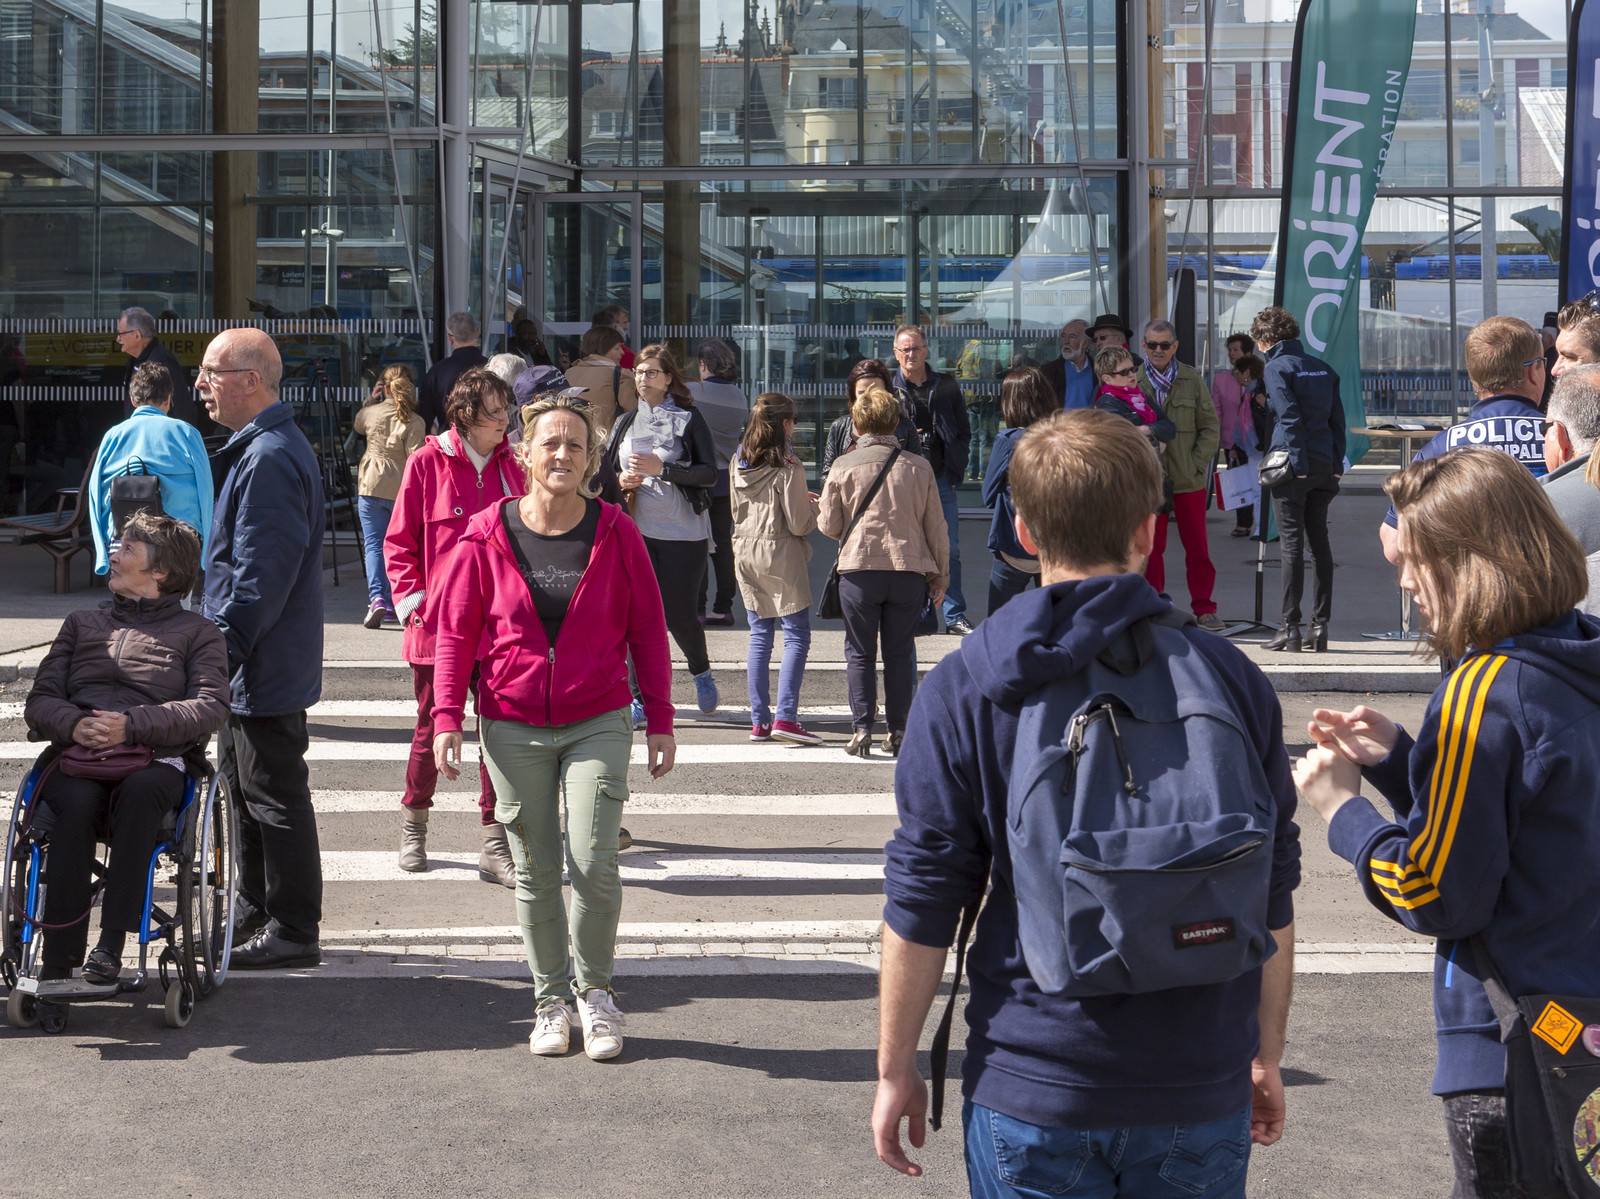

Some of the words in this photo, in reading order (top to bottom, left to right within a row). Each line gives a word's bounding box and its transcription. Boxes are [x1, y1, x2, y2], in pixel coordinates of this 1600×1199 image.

[1293, 60, 1370, 353] ORiENT
[61, 340, 106, 353] VOUS
[1182, 926, 1227, 940] EASTPAK
